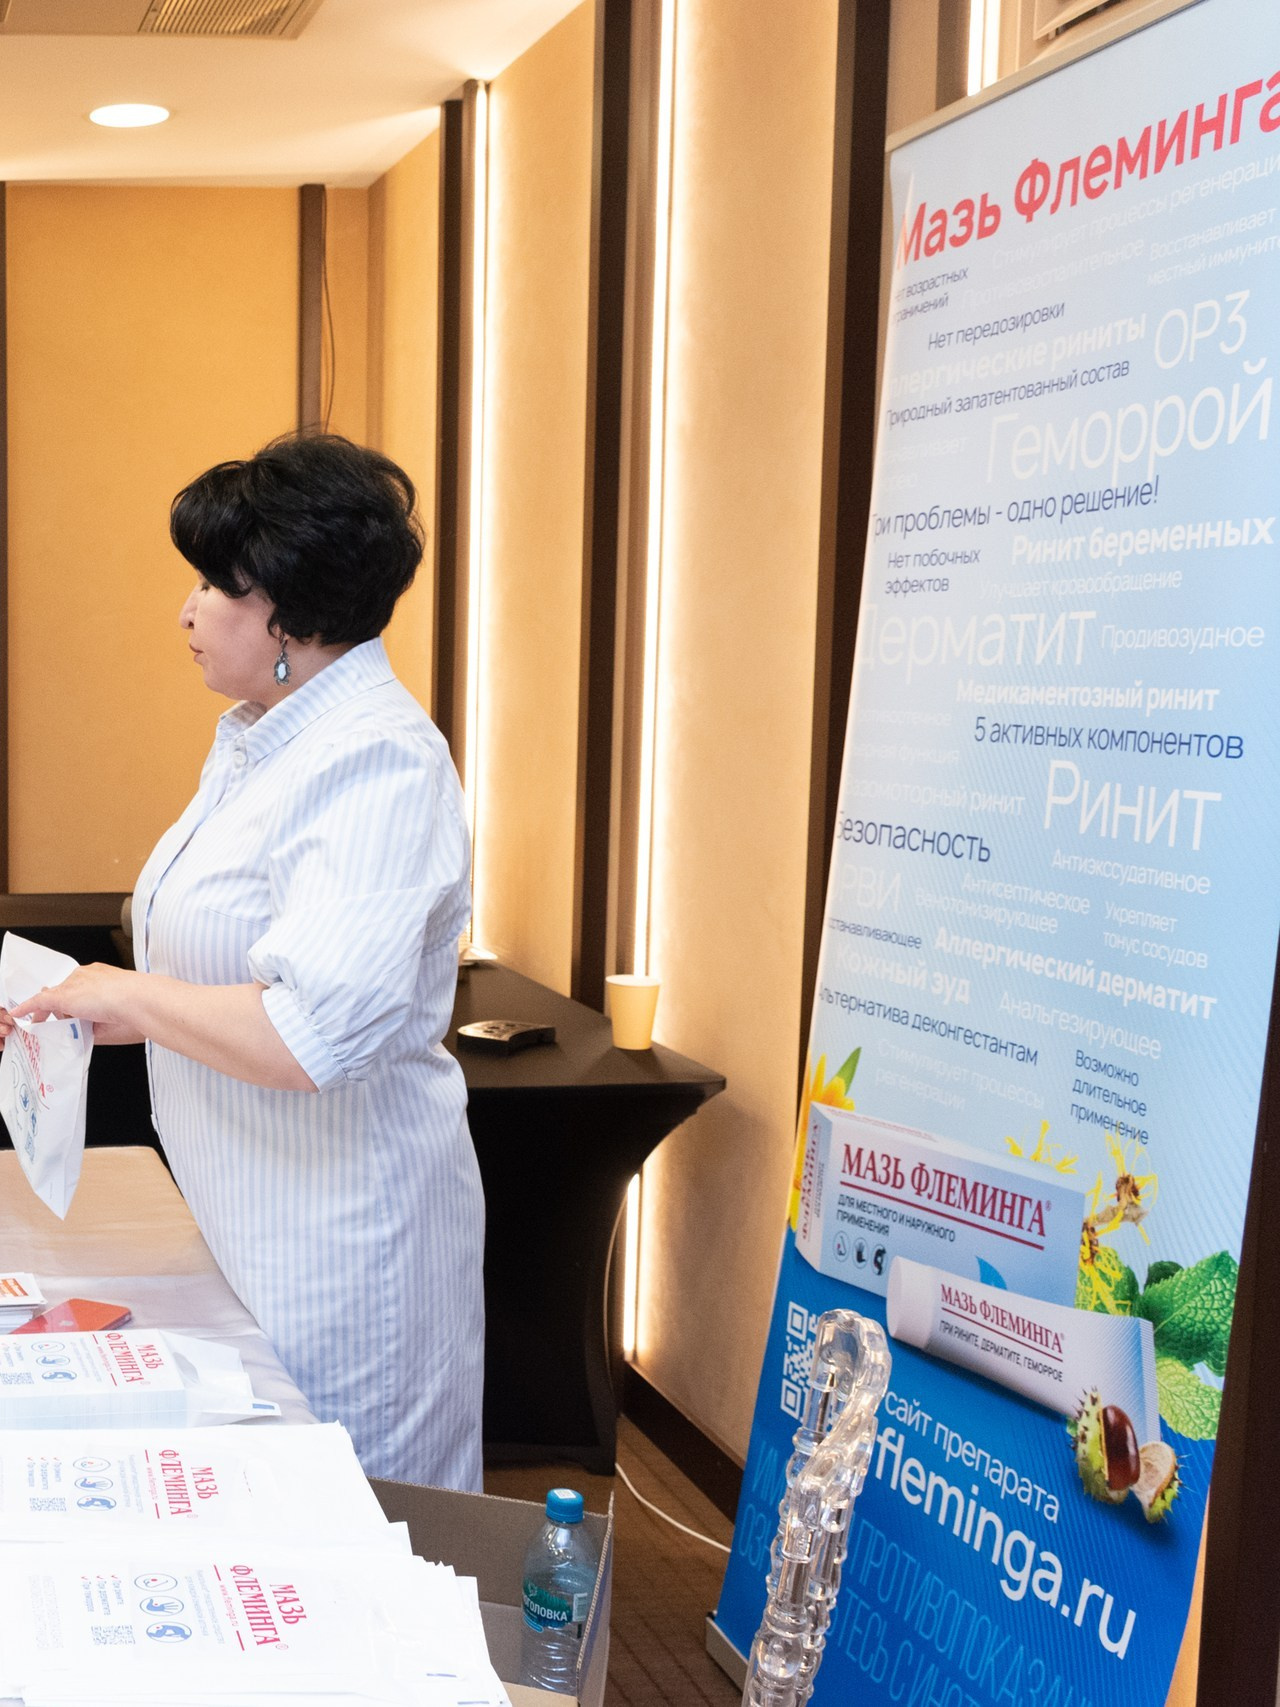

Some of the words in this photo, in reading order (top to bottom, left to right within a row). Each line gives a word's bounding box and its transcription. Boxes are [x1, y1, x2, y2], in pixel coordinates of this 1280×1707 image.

[896, 191, 1002, 271] Мазь
[1014, 69, 1280, 224] Флеминга
[1169, 153, 1280, 217] регенераци
[1149, 207, 1277, 261] Восстанавливает
[928, 329, 954, 351] Нет
[955, 302, 1066, 346] передозировки
[1051, 311, 1147, 373] риниты
[1154, 289, 1251, 370] ОРЗ
[954, 367, 1079, 414] запатентованный
[1080, 359, 1130, 389] состав
[986, 357, 1274, 494] Геморрой
[893, 503, 991, 540] проблемы
[1007, 493, 1057, 526] одно
[1060, 474, 1161, 520] решение!
[887, 550, 911, 570] Нет
[912, 547, 981, 569] побочных
[1012, 528, 1086, 566] Ринит
[1088, 516, 1277, 567] беременных
[884, 574, 950, 598] эффектов
[1051, 569, 1184, 600] кровообращение
[859, 602, 1097, 685] Дерматит
[956, 677, 1144, 710] Медикаментозный
[1145, 685, 1221, 718] ринит
[973, 714, 987, 744] 5
[989, 720, 1083, 751] активных
[1087, 722, 1244, 761] компонентов
[1043, 759, 1222, 852] Ринит
[832, 861, 903, 914] РВИ
[961, 871, 1091, 916] Антисептическое
[1051, 849, 1211, 895] Антиэкссудативное
[1104, 900, 1179, 935] Укрепляет
[933, 926, 1096, 990] Аллергический
[1097, 970, 1219, 1021] дерматит
[1101, 930, 1140, 959] тонус
[1140, 941, 1209, 971] сосудов
[837, 943, 928, 991] Кожный
[929, 968, 971, 1008] зуд
[910, 1012, 1039, 1068] деконгестантам
[998, 991, 1162, 1061] Анальгезирующее
[1074, 1049, 1140, 1087] Возможно
[1071, 1077, 1148, 1118] длительное
[1069, 1102, 1150, 1145] применение
[840, 1142, 906, 1189] МАЗЬ
[835, 1208, 890, 1238] ПРИМЕНЕНИЯ
[837, 1193, 855, 1208] ДЛЯ
[854, 1198, 898, 1225] МЕСТНОГО
[904, 1214, 956, 1243] НАРУЖНОГО
[940, 1283, 978, 1315] МАЗЬ
[136, 1343, 164, 1369] МАЗЬ
[939, 1319, 954, 1337] ПРИ
[1023, 1355, 1064, 1384] ГЕМОРРОЕ
[883, 1386, 929, 1437] сайт
[933, 1422, 1061, 1525] препарата
[190, 1466, 219, 1500] МАЗЬ
[269, 1583, 308, 1625] МАЗЬ
[524, 1594, 568, 1622] ГОЛОВКА
